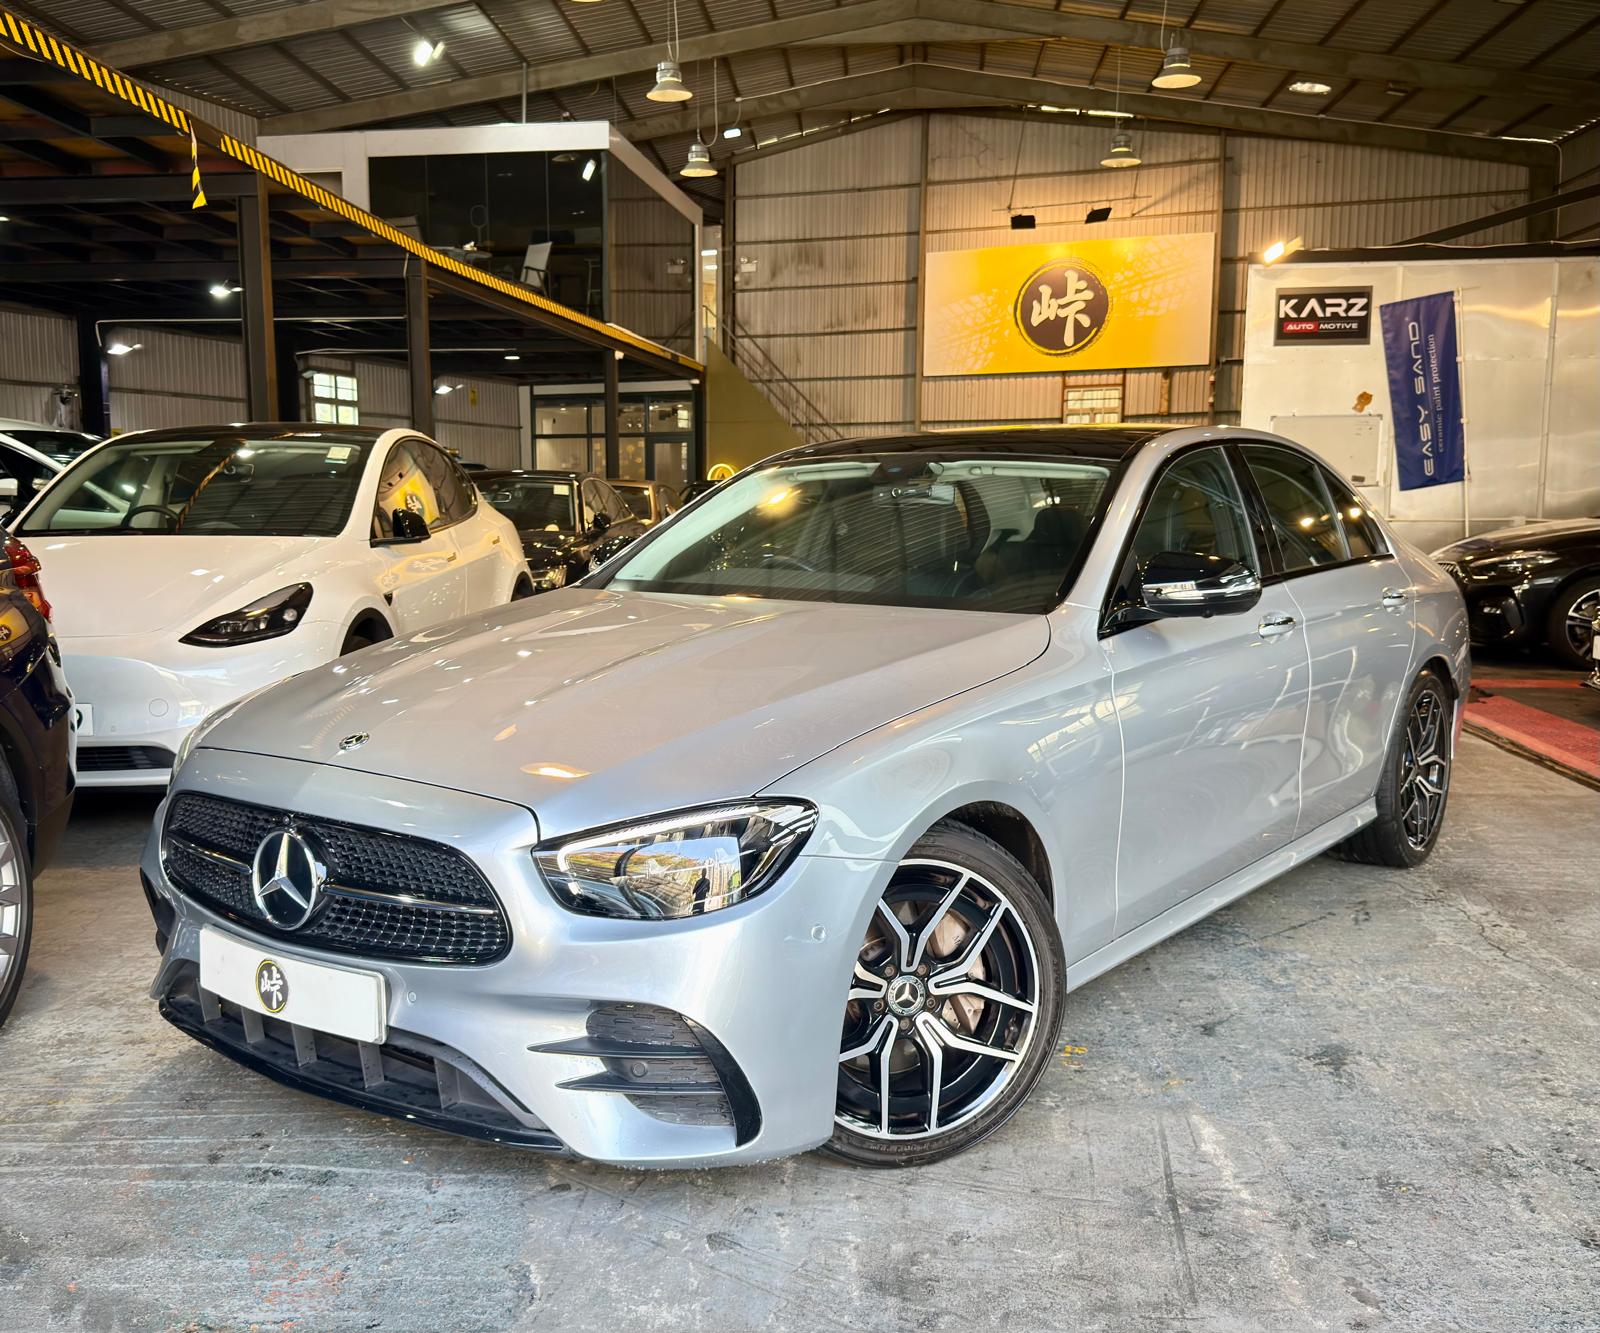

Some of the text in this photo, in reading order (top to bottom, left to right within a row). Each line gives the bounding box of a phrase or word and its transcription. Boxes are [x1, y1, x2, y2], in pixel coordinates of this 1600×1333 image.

[1030, 269, 1095, 347] 峠
[1279, 297, 1368, 319] KARZ
[1286, 322, 1359, 331] AUTO MOTIVE
[1408, 321, 1434, 477] EASY SAND
[1427, 333, 1444, 453] ceramic paint protection
[261, 965, 283, 1009] 峠
